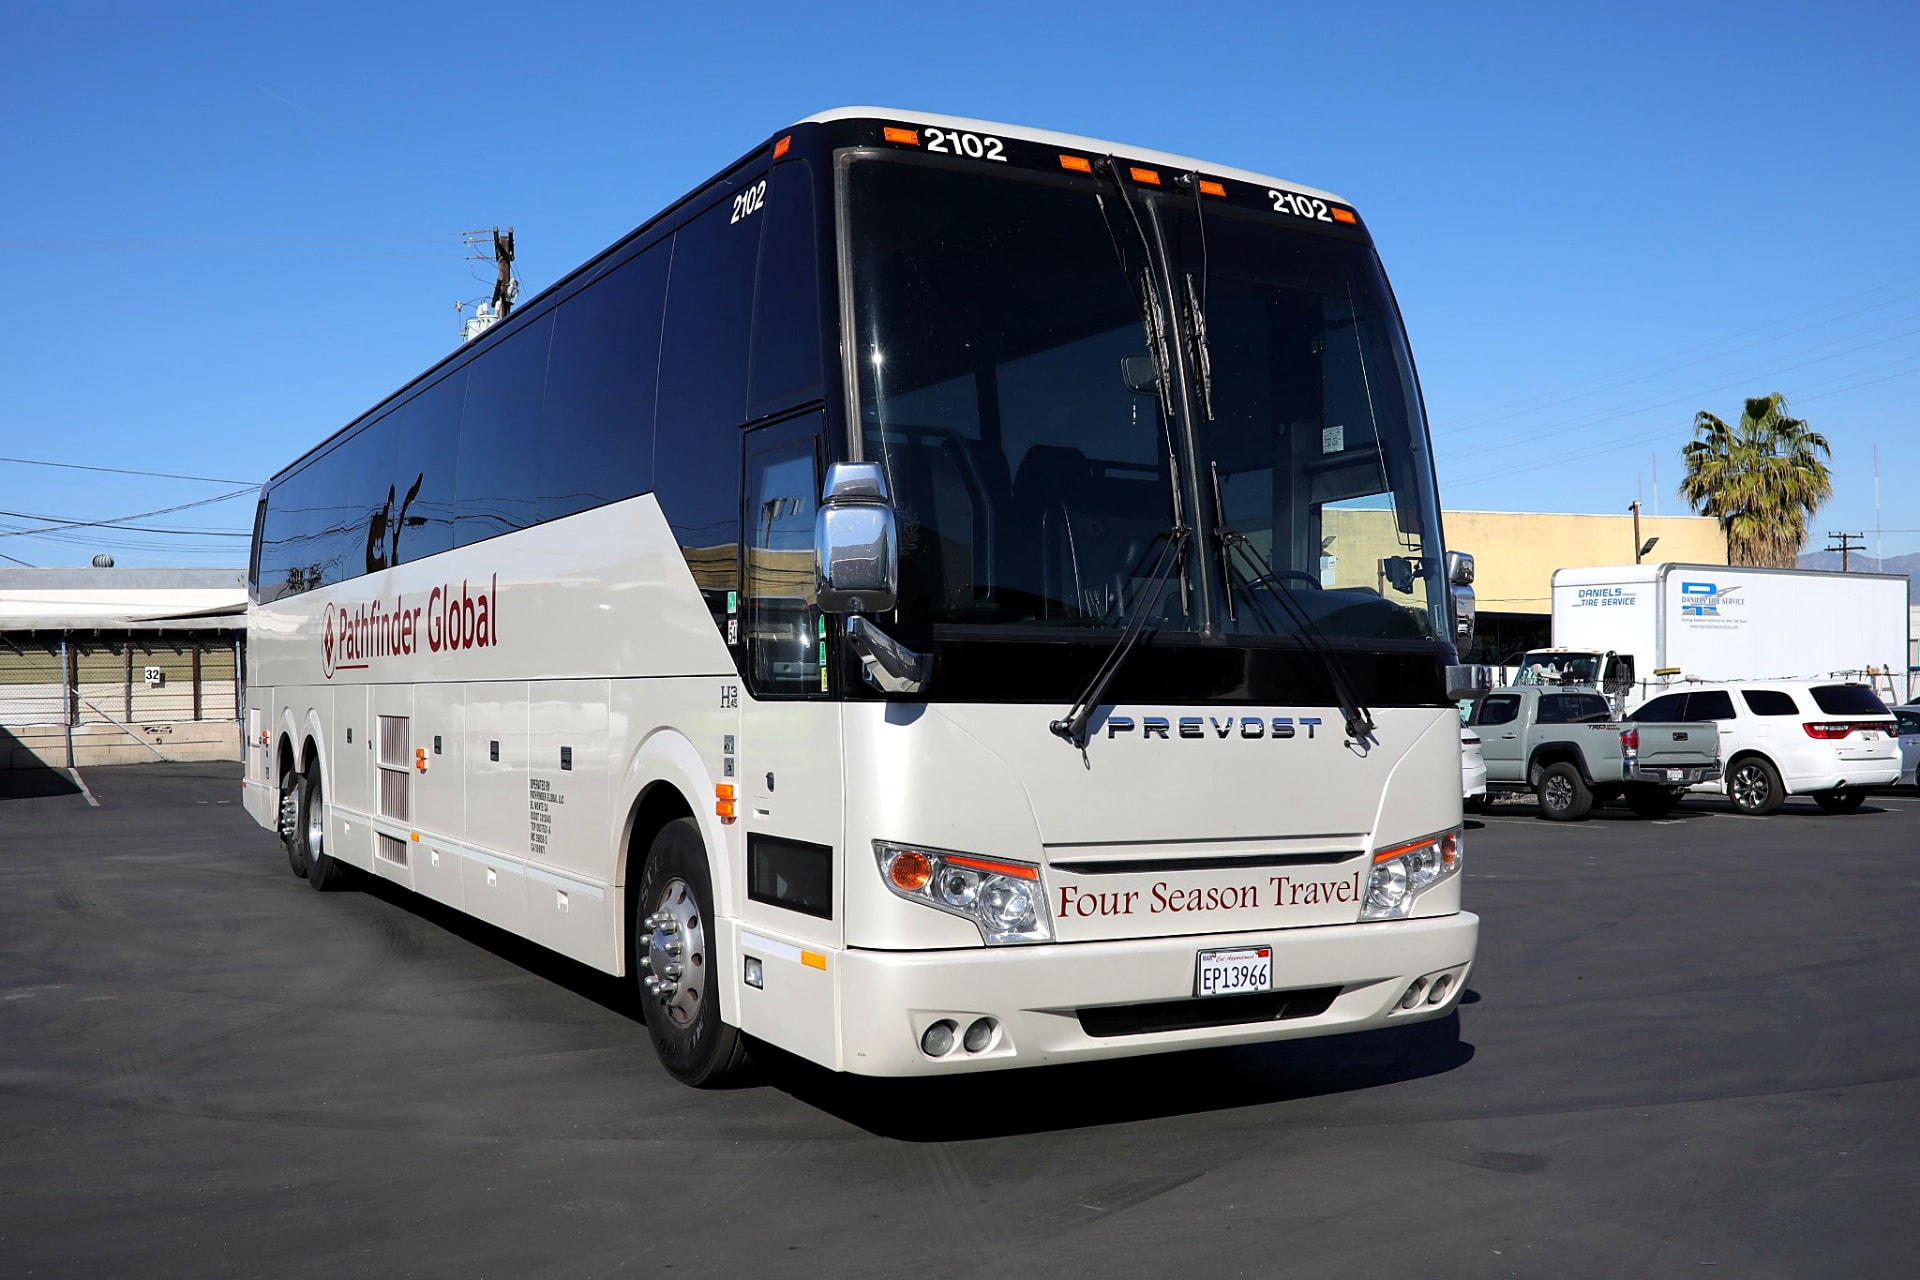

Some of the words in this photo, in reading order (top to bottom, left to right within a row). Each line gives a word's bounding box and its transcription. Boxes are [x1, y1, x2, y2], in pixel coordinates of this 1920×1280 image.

[924, 128, 1007, 162] 2102
[730, 180, 766, 224] 2102
[1268, 190, 1333, 222] 2102
[1578, 588, 1622, 598] DANIELS
[1581, 599, 1599, 607] TIRE
[1601, 597, 1636, 606] SERVICE
[339, 594, 421, 660] Pathfinder
[428, 571, 498, 653] Global
[145, 669, 159, 680] 32
[1107, 716, 1322, 739] PREVOST
[1057, 885, 1139, 917] Four
[1150, 882, 1259, 913] Season
[1270, 871, 1361, 906] Travel
[1203, 964, 1267, 990] EP13966
